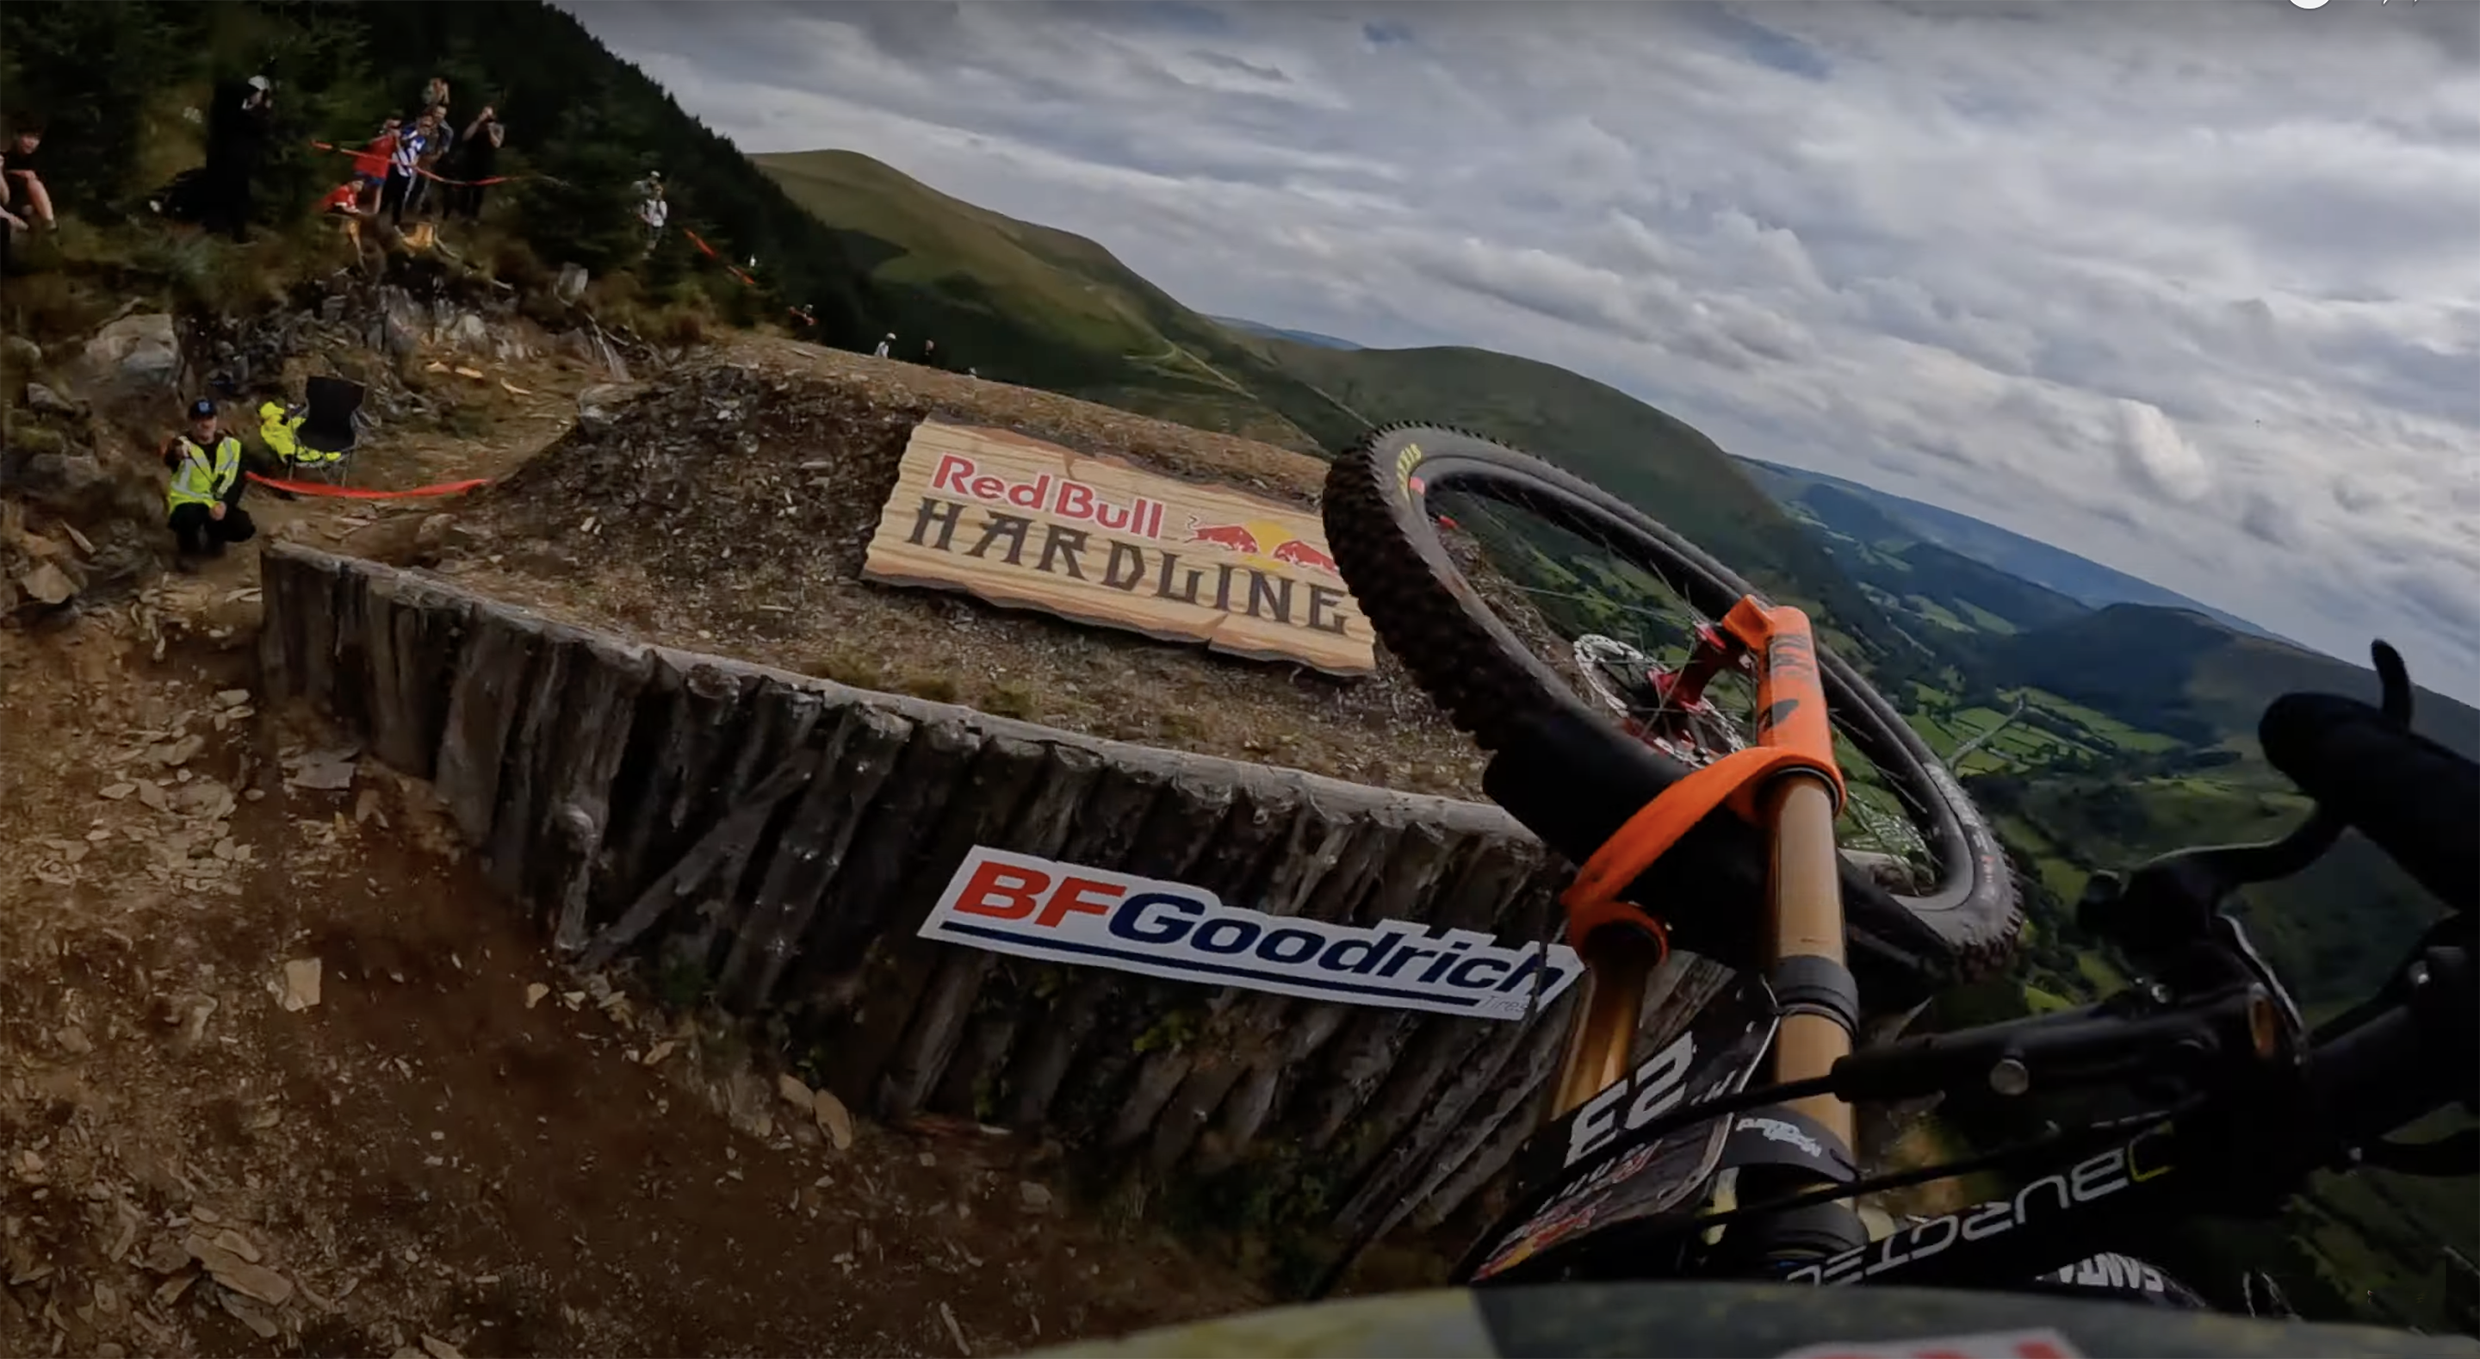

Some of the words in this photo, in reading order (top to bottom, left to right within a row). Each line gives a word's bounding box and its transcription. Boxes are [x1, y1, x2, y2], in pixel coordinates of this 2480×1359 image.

[907, 497, 1351, 635] HARDLINE
[932, 454, 1050, 510] Red
[1054, 481, 1163, 540] Bull
[952, 860, 1569, 998] BFGoodrich
[1564, 1030, 1694, 1169] 23
